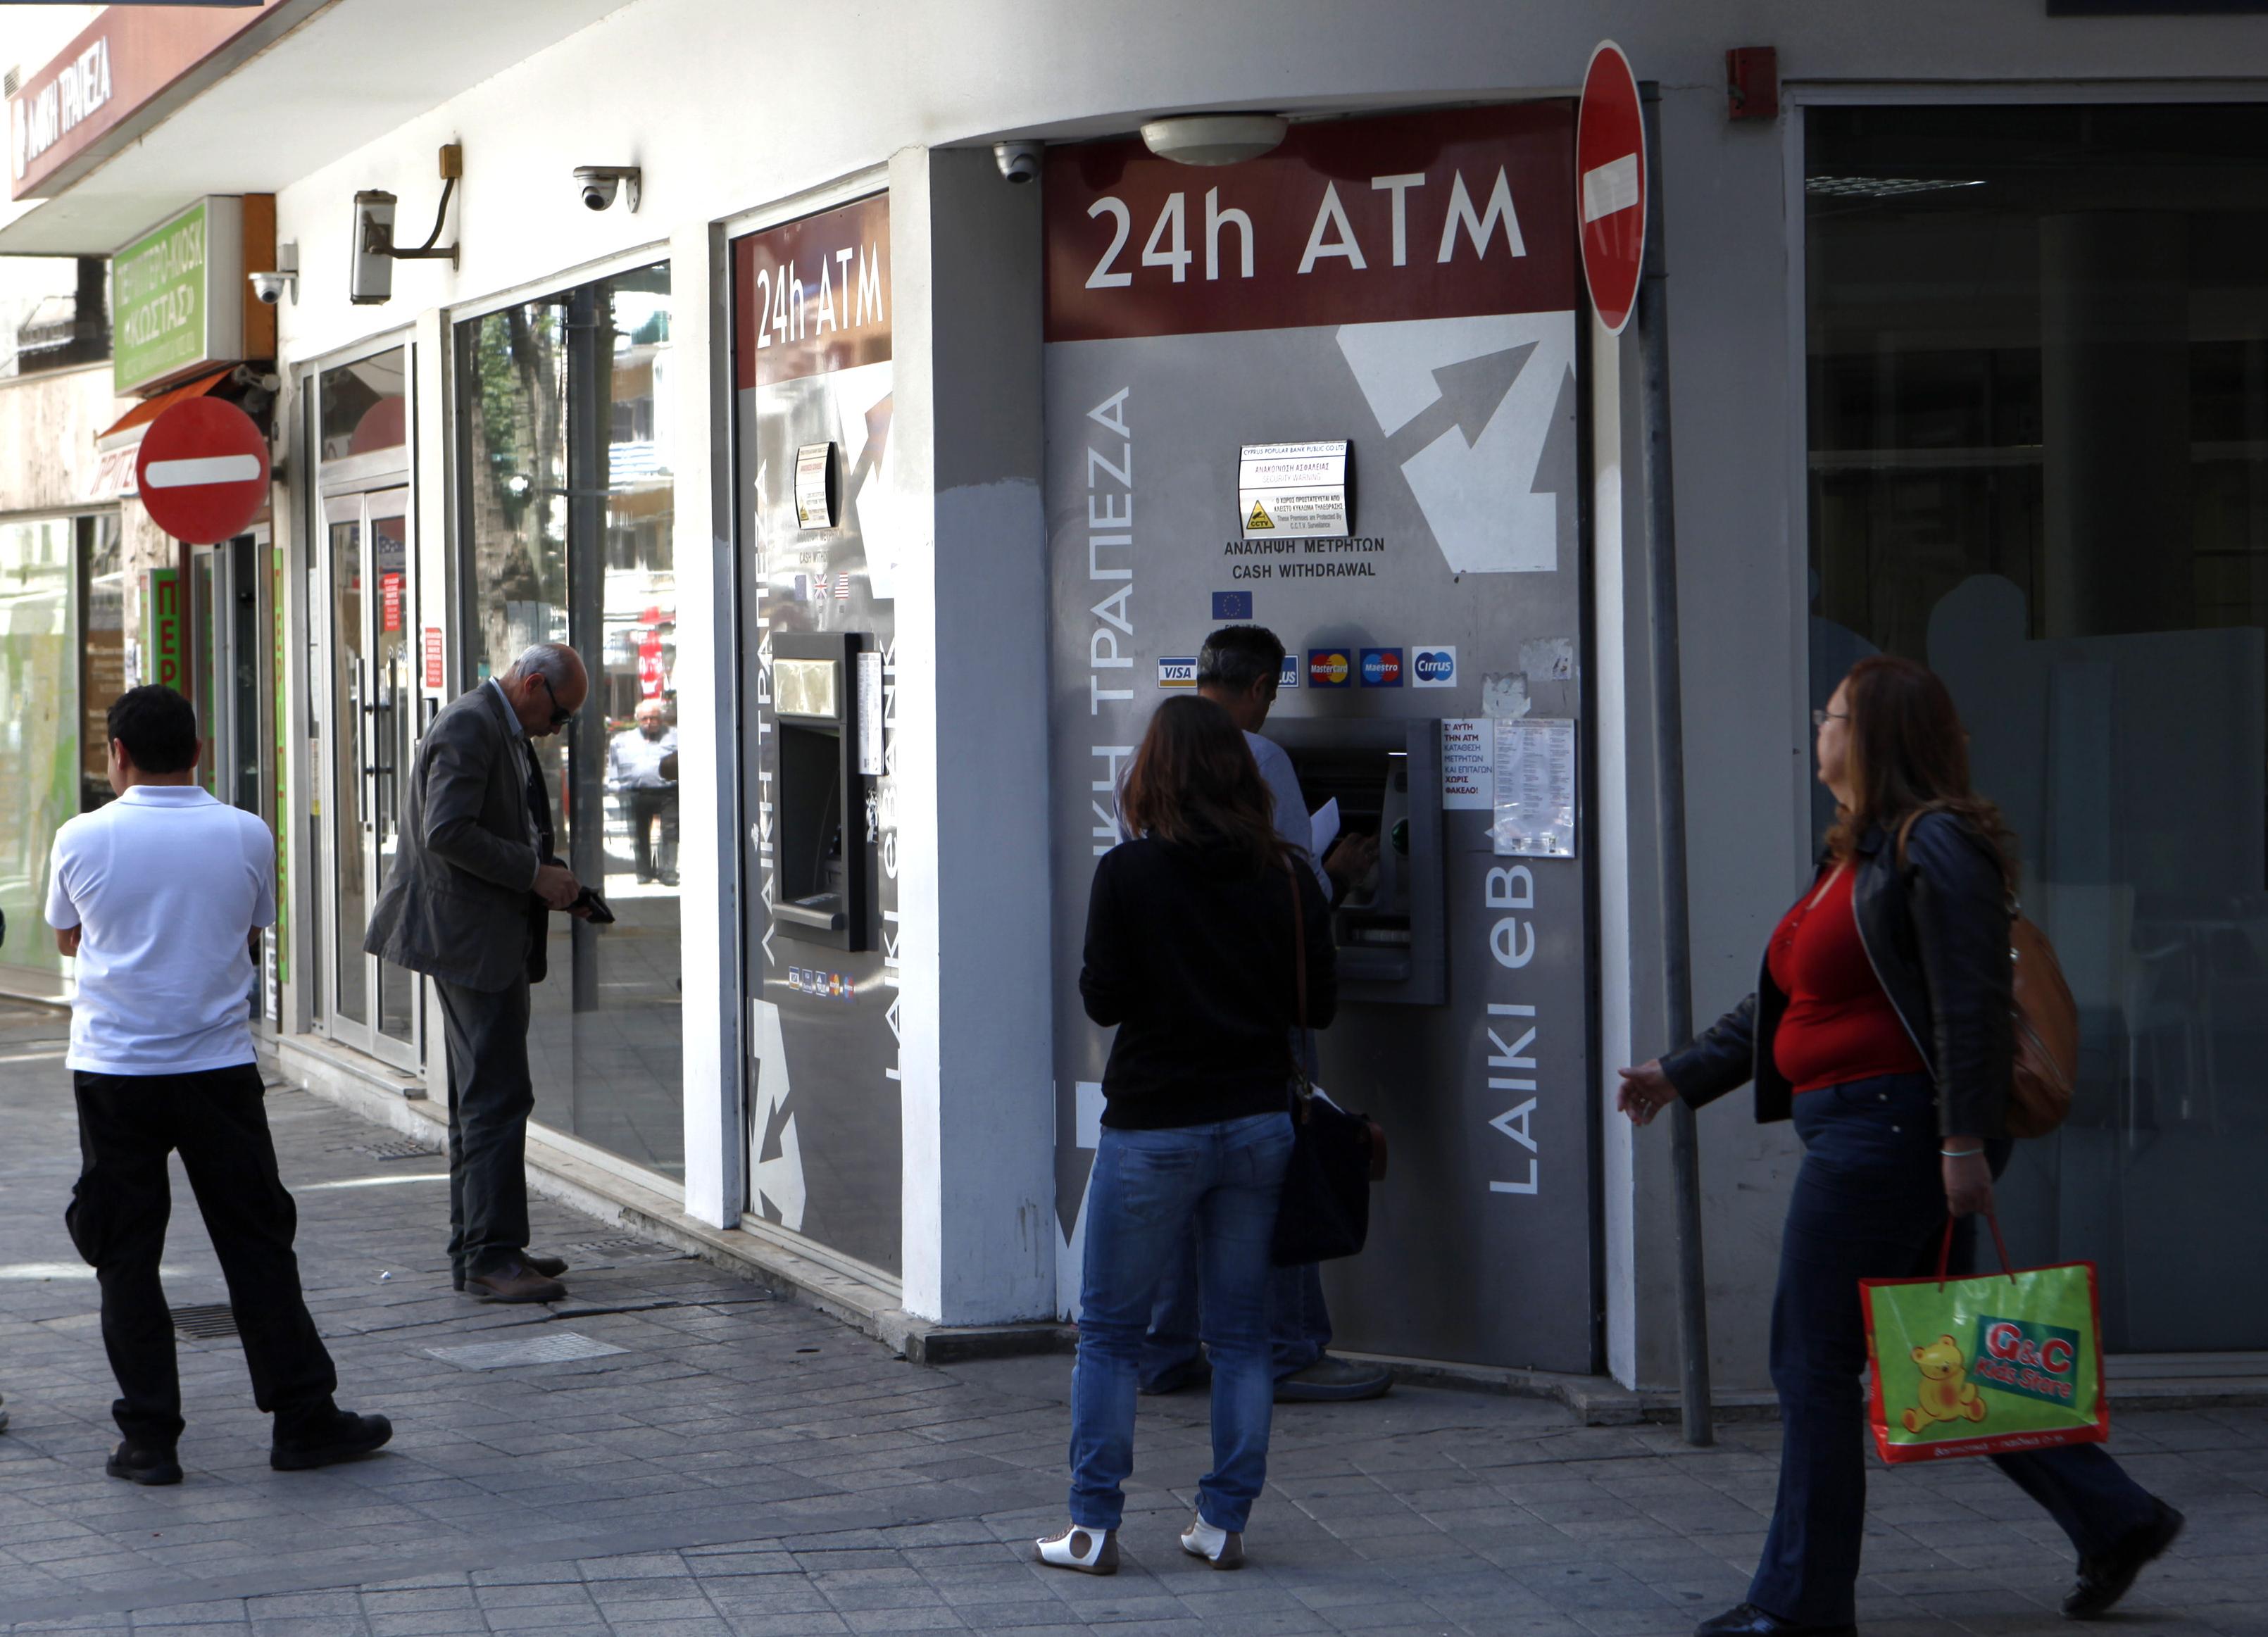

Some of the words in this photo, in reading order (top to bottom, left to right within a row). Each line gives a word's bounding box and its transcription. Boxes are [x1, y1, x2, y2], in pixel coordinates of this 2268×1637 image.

[1084, 185, 1255, 289] 24h
[1297, 164, 1527, 274] ATM
[757, 258, 805, 349] 24h
[815, 241, 883, 336] ATM
[1255, 465, 1294, 473] ΑΝΑΚΟΙΝΩΣΗ
[1296, 463, 1329, 471] ΑΣΦΑΛΕΙΑΣ
[1087, 387, 1134, 715] ΤΡΑΠΕΖΑ
[1224, 540, 1296, 555] ΑΝΑΛΗΨΗ
[1304, 538, 1384, 553] ΜΕΤΡΗΤΩΝ
[1232, 564, 1272, 579] CASH
[1279, 562, 1376, 578] WITHDRAWAL
[754, 458, 772, 746] ΤΡΑΠΕΖΑ
[1164, 667, 1191, 679] VISA
[1310, 664, 1348, 674] MasterCard
[1365, 663, 1398, 672] Maestro
[1417, 659, 1451, 672] Cirrus
[1444, 744, 1481, 752] ΚΑΤΑΘΕΣΗ
[1445, 765, 1457, 774] ΚΑΙ
[1458, 765, 1493, 774] ΕΠΙΤΑΓΩΝ
[1445, 786, 1479, 795] ΦΑΚΕΛΟ!
[1487, 1003, 1538, 1195] LAIKI
[1986, 1322, 2074, 1374] G&C
[1974, 1357, 2016, 1385] Kids
[2017, 1369, 2072, 1399] Store
